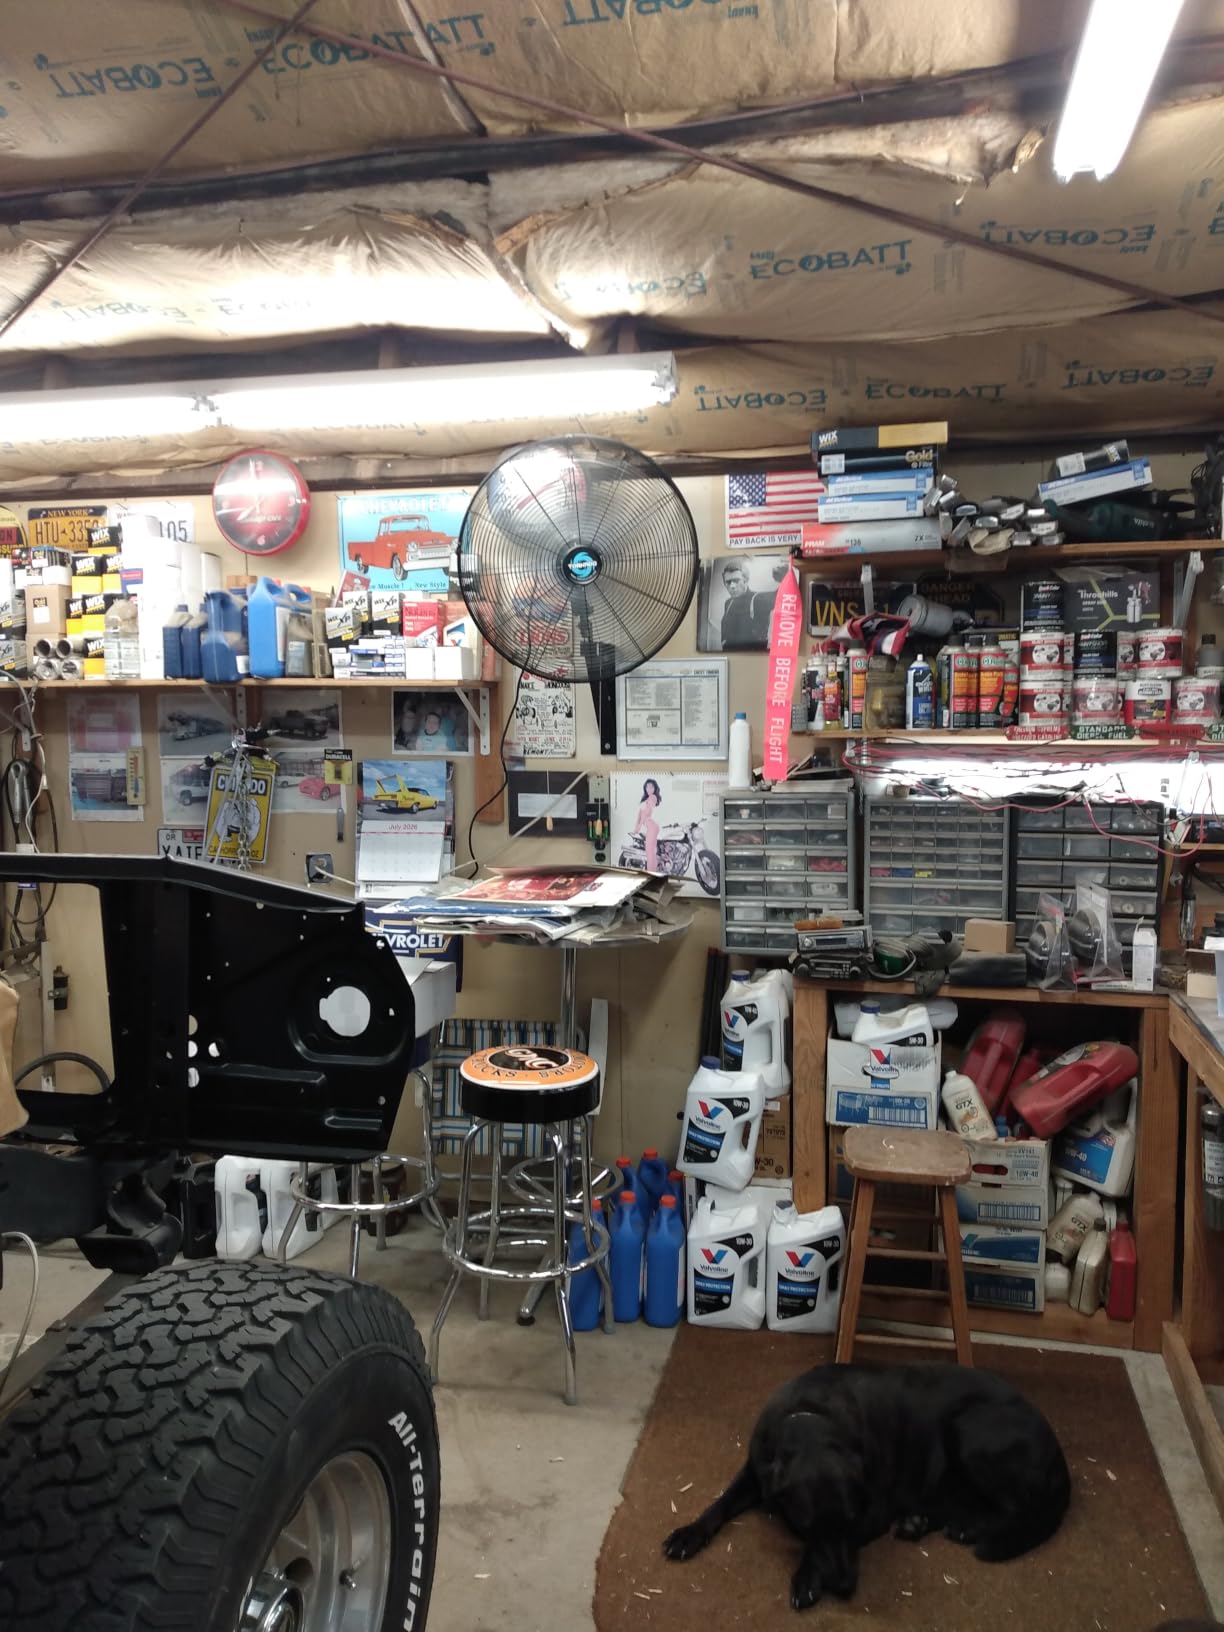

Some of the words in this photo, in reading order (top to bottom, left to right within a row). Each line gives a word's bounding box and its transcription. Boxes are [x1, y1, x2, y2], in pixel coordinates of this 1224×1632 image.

[49, 57, 215, 98] ECOBATT
[983, 223, 1156, 247] ECOBATT
[750, 239, 913, 280] ECOBATT
[1061, 366, 1214, 390] ECOBATT
[866, 383, 1007, 400] ECOBATT
[696, 388, 828, 412] ECOBATT
[818, 430, 838, 444] WIX
[905, 449, 933, 462] Gold
[35, 521, 60, 545] HTU
[91, 527, 109, 540] WIX
[729, 537, 744, 546] PAY
[745, 537, 766, 545] BACK
[768, 535, 775, 543] IS
[777, 534, 798, 542] VERY
[85, 595, 105, 608] WIX
[777, 593, 798, 647] REMOVE
[772, 657, 791, 707] BEFORE
[1079, 725, 1127, 733] STANDARD
[768, 716, 786, 764] FLIGHT
[325, 753, 352, 761] DURACELL
[388, 823, 402, 832] July
[402, 823, 418, 831] 2026
[955, 1098, 973, 1111] GTX
[695, 1115, 722, 1129] Valvoline
[700, 1263, 729, 1273] Valvoline
[785, 1266, 815, 1276] Valvoline
[388, 1411, 425, 1632] All-Terrain
